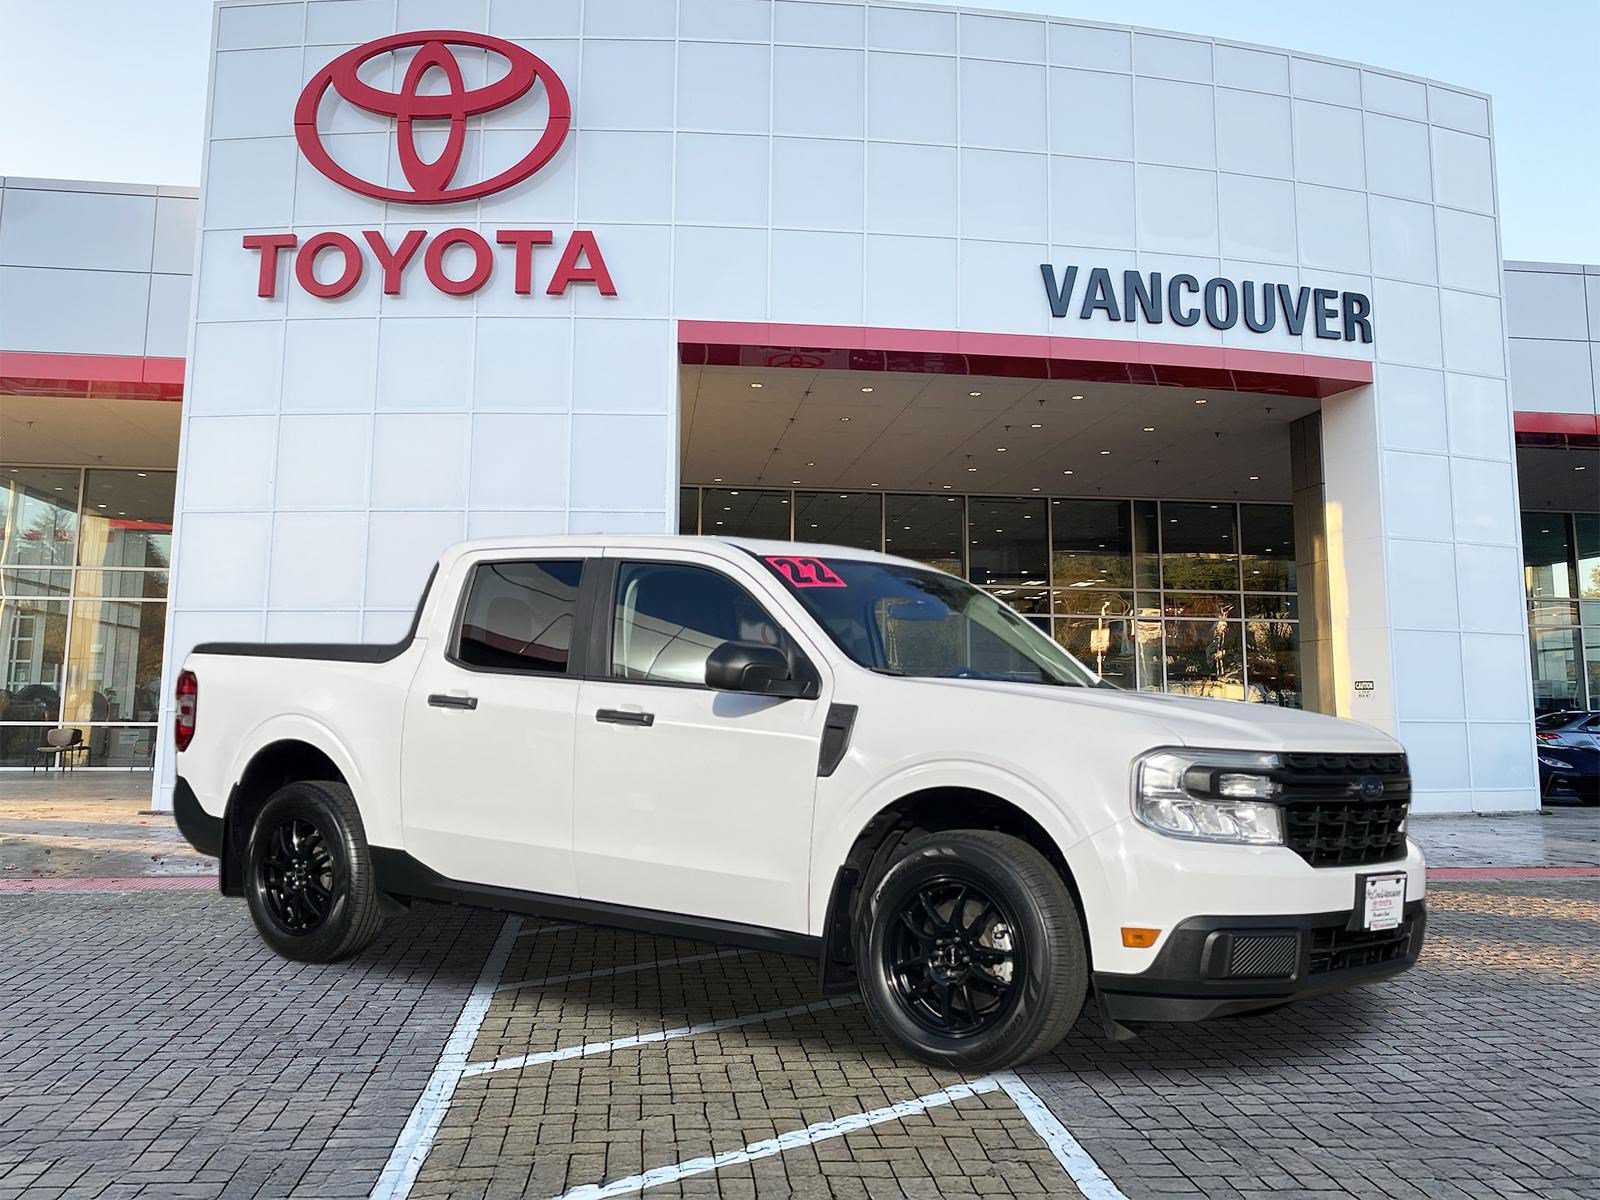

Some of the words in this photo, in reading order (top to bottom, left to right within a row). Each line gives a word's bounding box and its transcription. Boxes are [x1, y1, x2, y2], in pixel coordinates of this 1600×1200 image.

[243, 228, 618, 298] TOYOTA
[1040, 263, 1374, 344] VANCOUVER
[773, 558, 837, 584] 22
